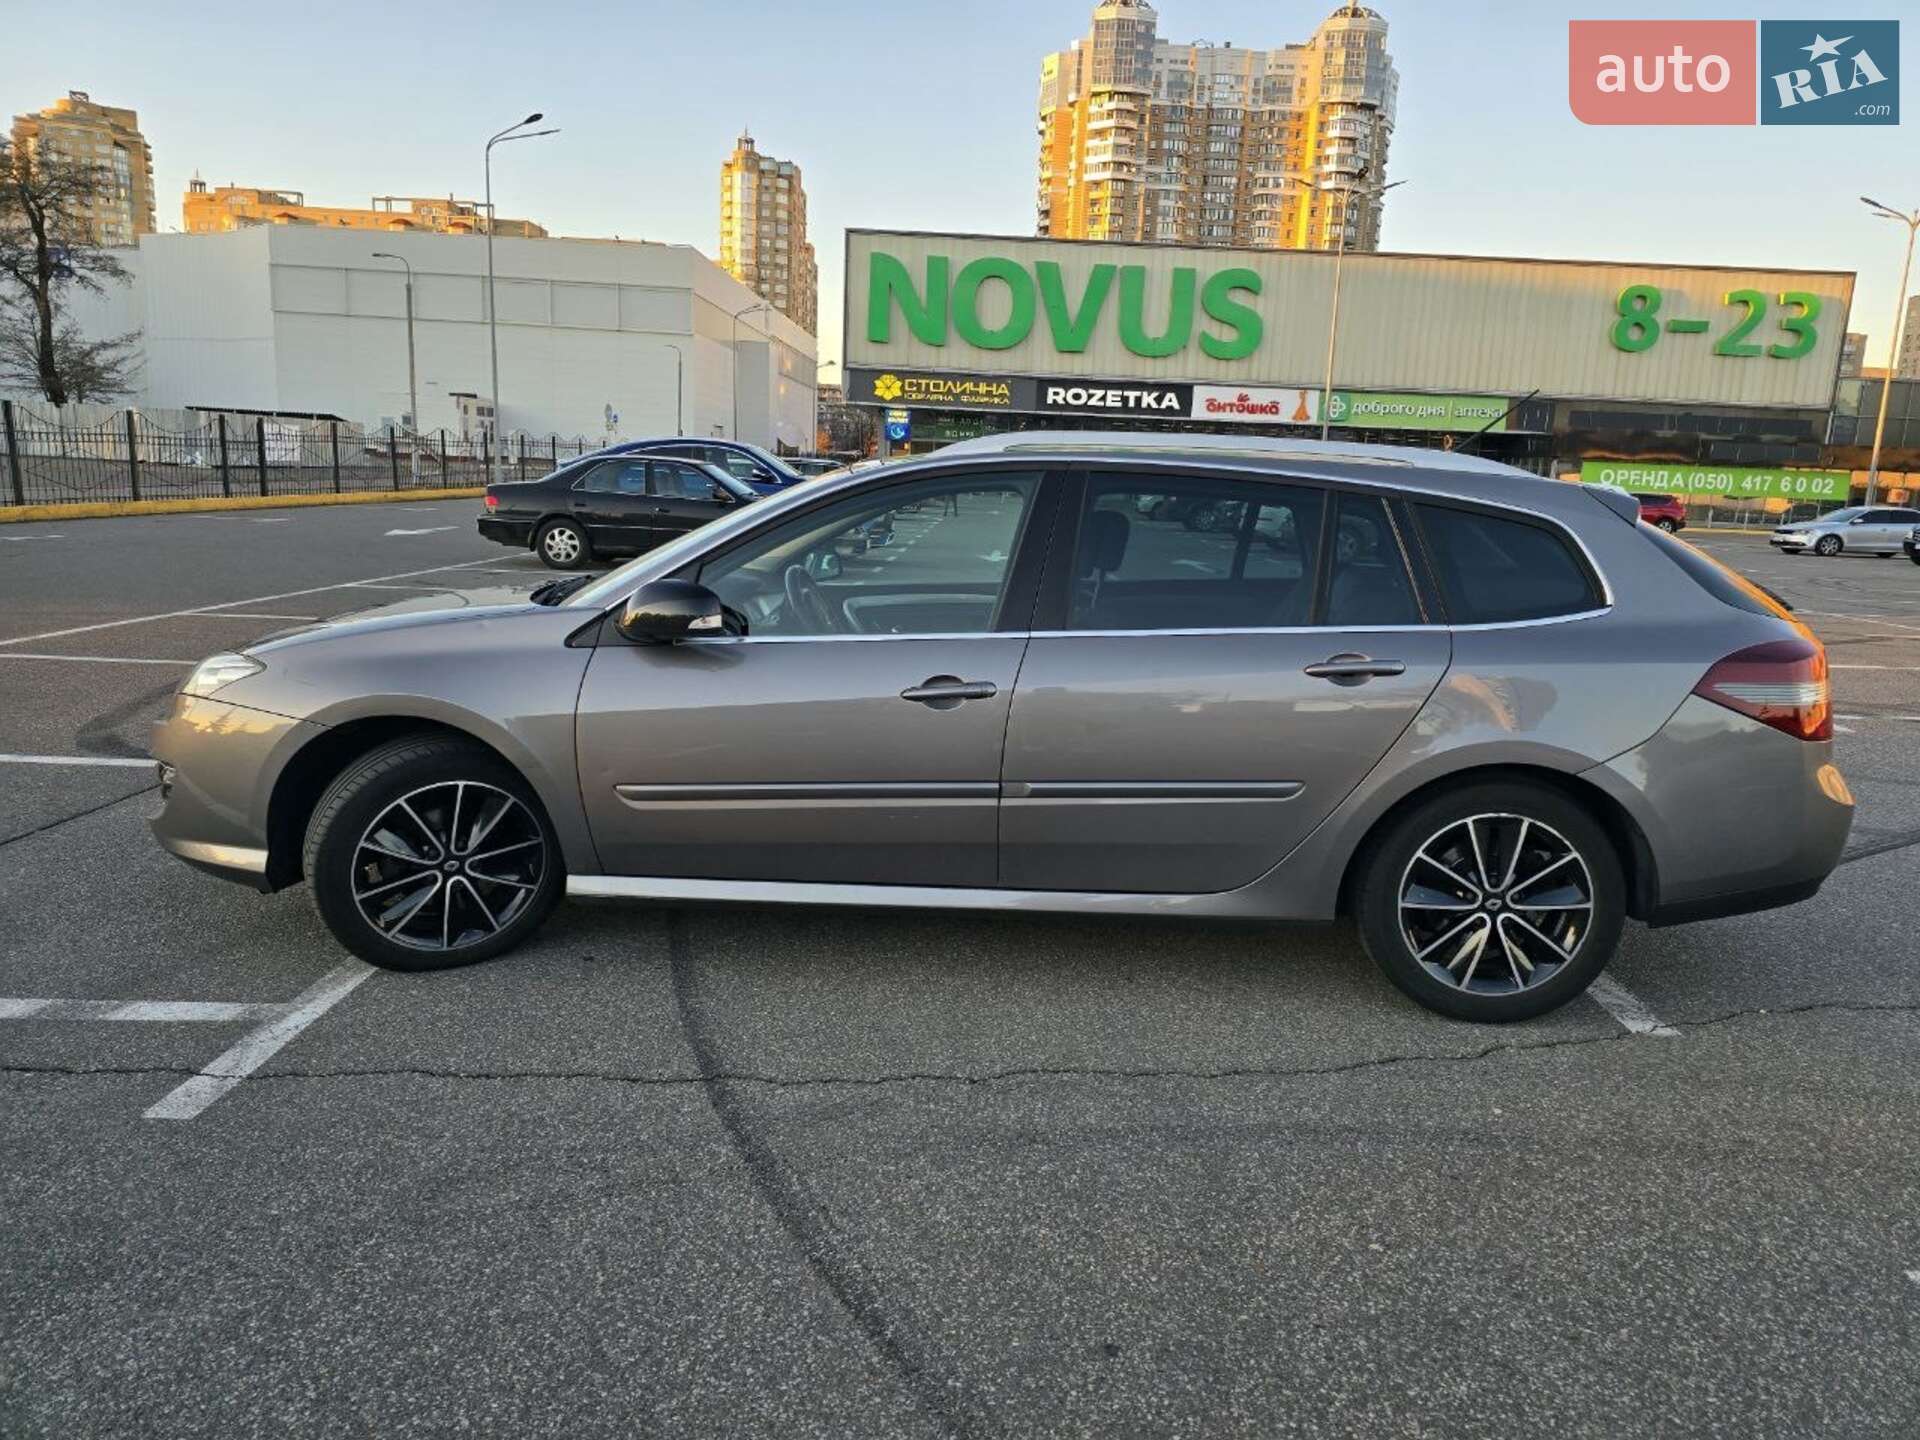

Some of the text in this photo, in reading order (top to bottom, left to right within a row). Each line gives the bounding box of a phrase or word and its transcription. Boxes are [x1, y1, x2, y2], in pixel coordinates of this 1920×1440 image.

[867, 252, 1264, 361] NOVUS
[904, 378, 1010, 396] СТОЛИЧНА
[1046, 386, 1181, 410] ROZETKA
[1351, 400, 1446, 418] доброго дня
[1455, 407, 1503, 418] аптека
[1600, 469, 1685, 489] ОРЕНДА
[1688, 472, 1733, 493] (050)
[1741, 475, 1773, 491] 417
